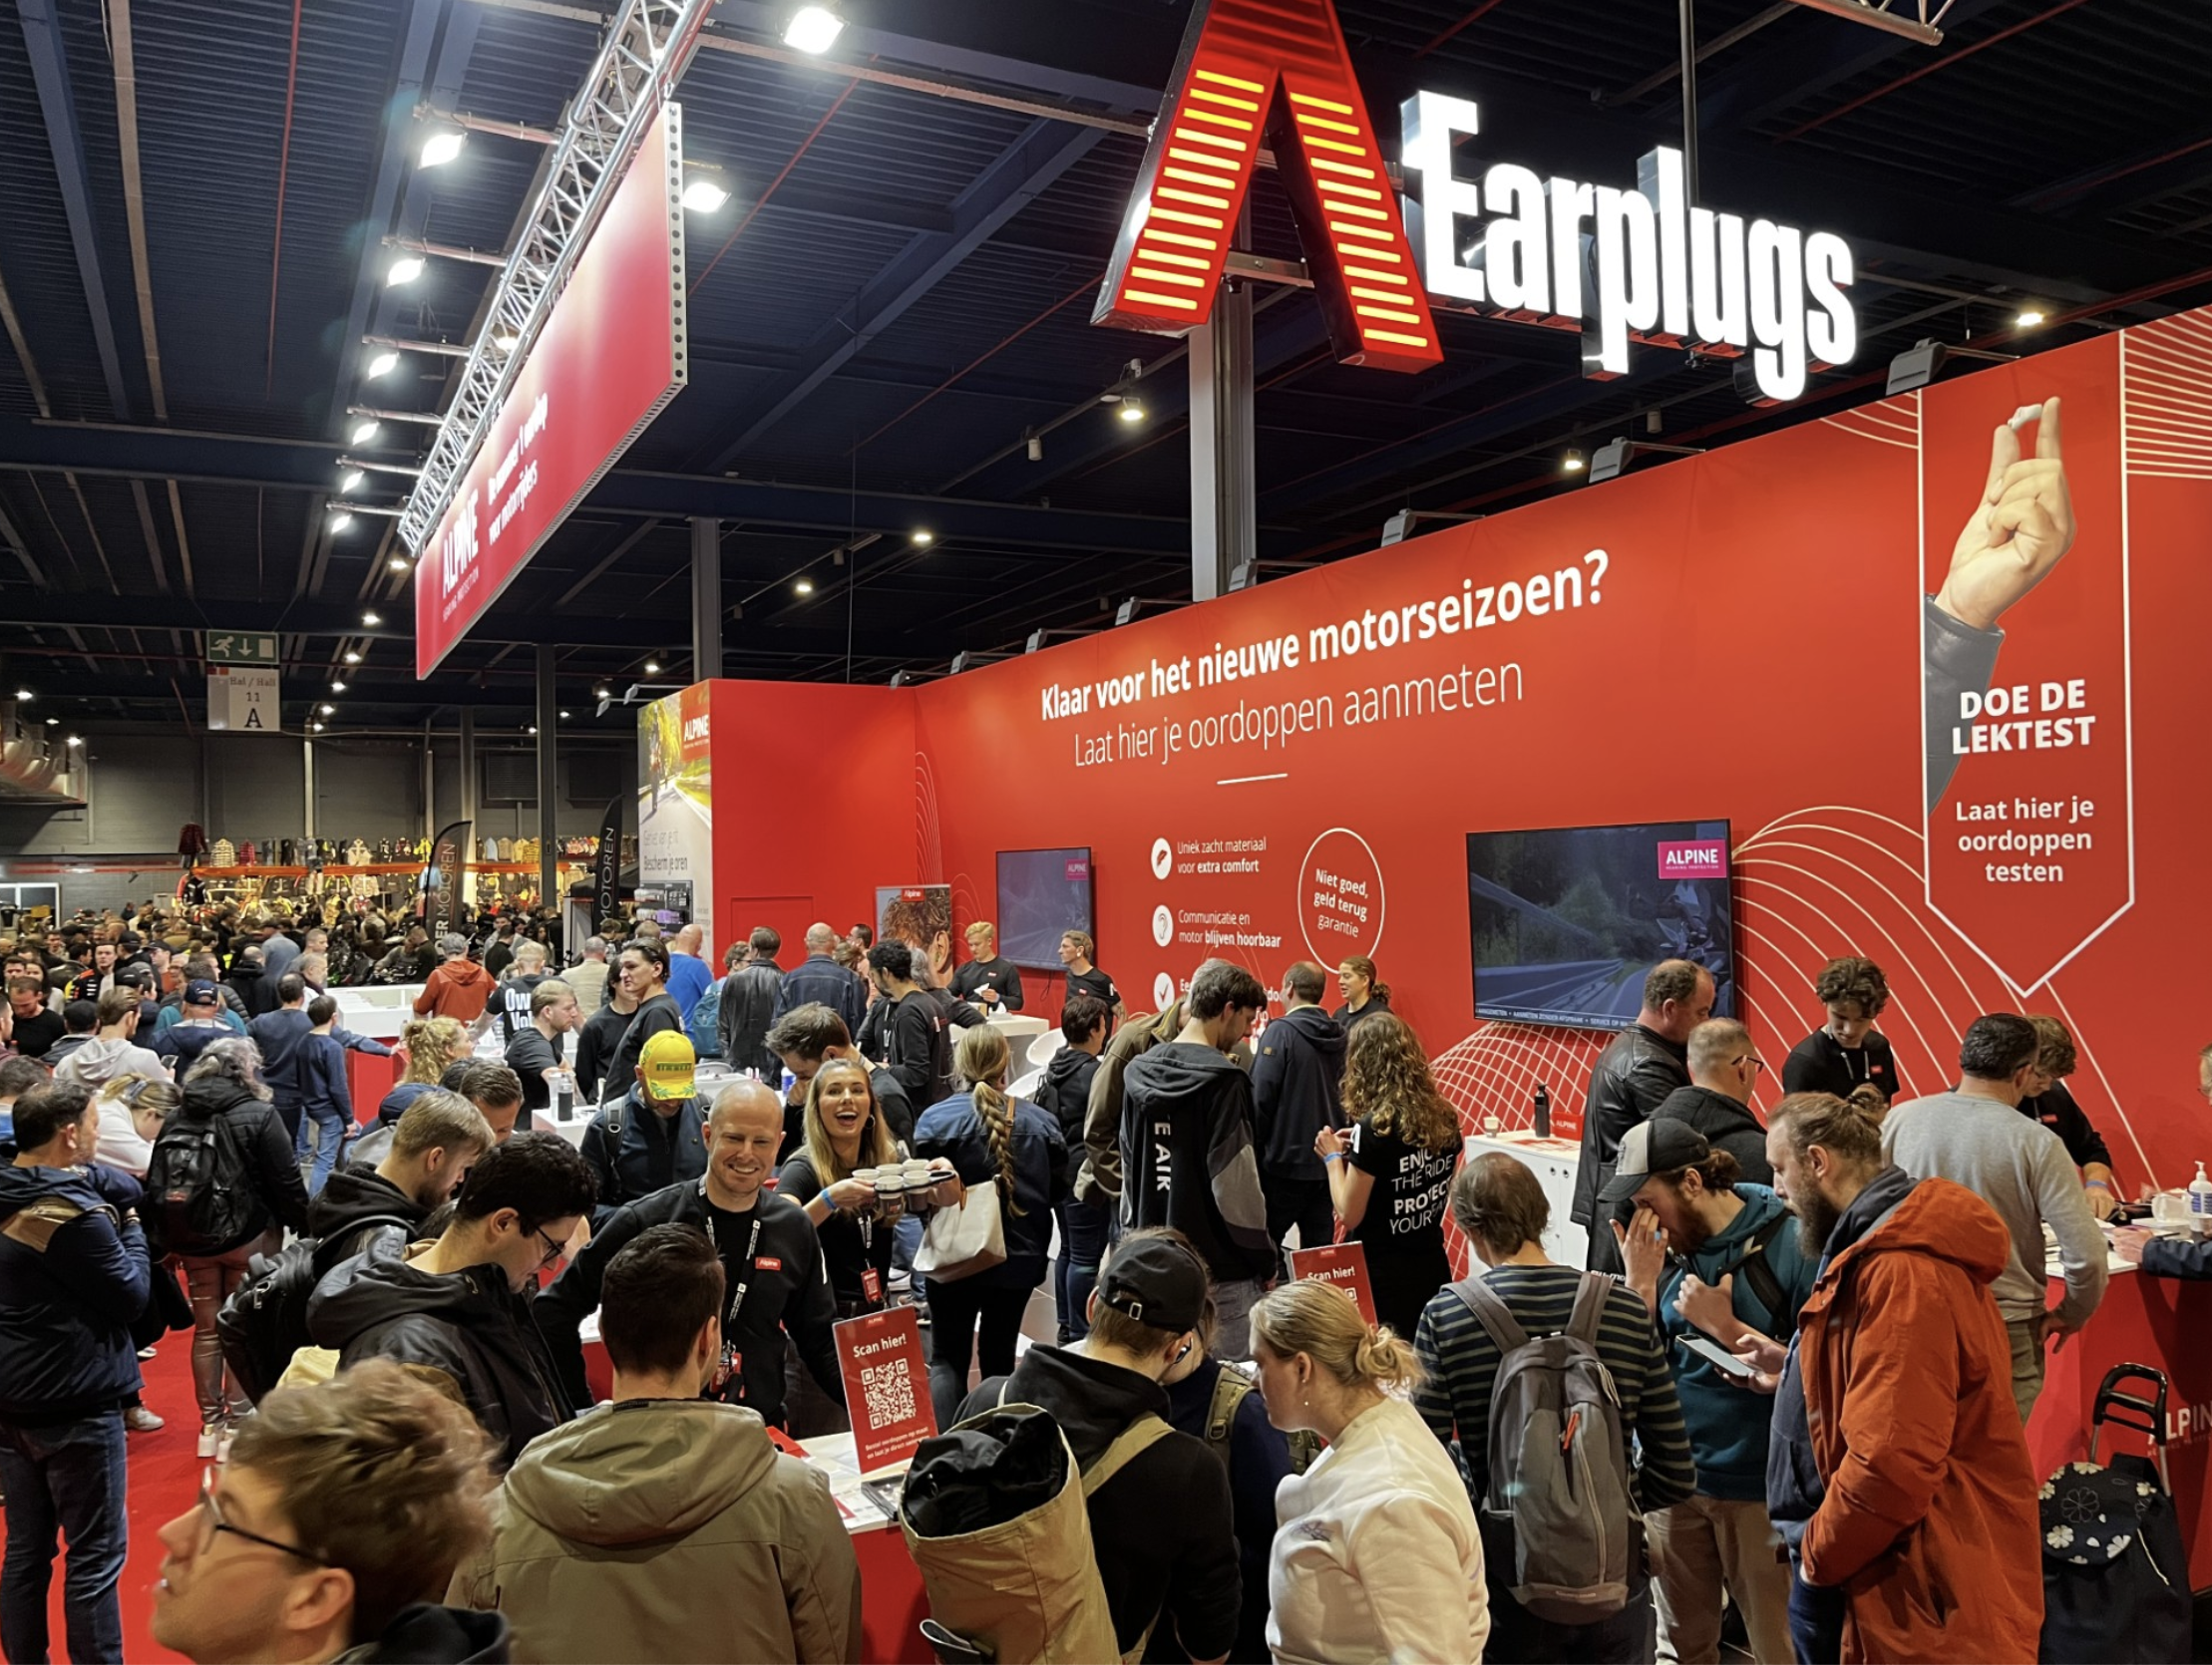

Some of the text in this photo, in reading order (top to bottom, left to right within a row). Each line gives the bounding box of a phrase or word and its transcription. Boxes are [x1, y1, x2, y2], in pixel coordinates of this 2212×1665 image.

[1400, 90, 1858, 401] Earplugs
[443, 489, 479, 599] ALPINE
[1041, 548, 1609, 721] Klaar voor het nieuwe motorseizoen?
[256, 677, 275, 686] Hall
[246, 692, 260, 702] 11
[1961, 679, 2085, 720] DOE DE
[244, 708, 263, 729] A
[1075, 663, 1522, 767] Laat hier je oordoppen aanmeten
[683, 714, 709, 742] ALPINE
[1952, 716, 2096, 755] LEKTEST
[1956, 796, 2094, 825] Laat hier je
[1177, 836, 1267, 854] Uniek zacht materiaal
[1665, 848, 1718, 864] ALPINE
[1958, 830, 2092, 857] oordoppen
[599, 827, 614, 925] MOTOREN
[1068, 863, 1087, 872] ALPINE
[1178, 858, 1260, 873] voor extra comfort
[1986, 862, 2063, 882] testen
[437, 843, 456, 916] MOTOREN
[1315, 868, 1368, 898] Niet goed,
[1178, 909, 1251, 924] Communicatie en
[1313, 889, 1367, 922] geld terug
[1178, 929, 1282, 948] motor blijven hoorbaar
[1317, 914, 1359, 938] garantie
[1180, 978, 1192, 992] Ee
[505, 987, 532, 1012] Ow
[511, 1011, 534, 1031] Vol
[1557, 1120, 1577, 1131] ALPINE
[1390, 1154, 1454, 1192] THE RIDE
[1399, 1148, 1434, 1173] ENJO
[1389, 1209, 1432, 1235] YOUR
[1332, 1265, 1355, 1279] hier!
[853, 1333, 908, 1358] Scan hier!
[2147, 1400, 2212, 1445] LPIN
